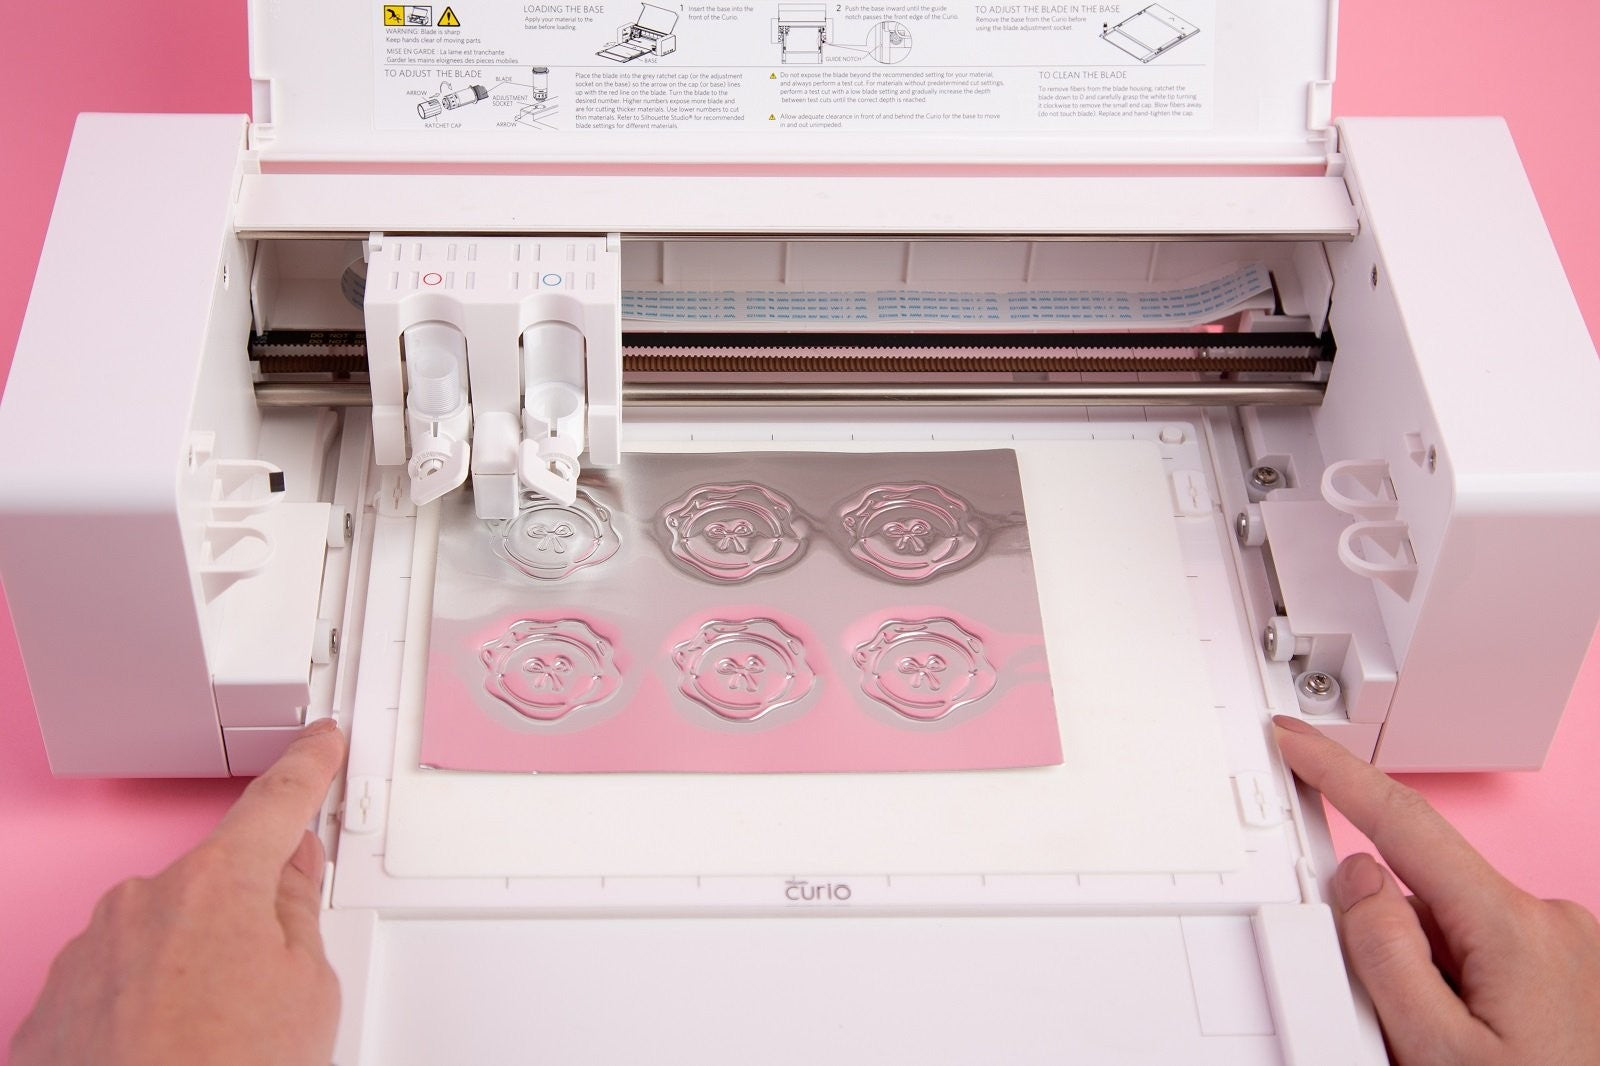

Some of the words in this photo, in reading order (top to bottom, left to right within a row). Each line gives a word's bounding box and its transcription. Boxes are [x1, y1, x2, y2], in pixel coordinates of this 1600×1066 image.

[931, 5, 947, 13] guide
[975, 5, 987, 14] TO
[989, 5, 1020, 14] ADJUST
[1023, 5, 1039, 14] THE
[1041, 5, 1068, 14] BLADE
[1070, 5, 1079, 14] IN
[1082, 5, 1097, 14] THE
[1099, 5, 1120, 14] BASE
[909, 13, 923, 21] edge
[444, 28, 460, 36] sharp
[976, 24, 991, 32] using
[1020, 24, 1052, 32] adjustment
[384, 70, 397, 78] TO
[399, 70, 432, 78] ADJUST
[436, 70, 452, 78] THE
[455, 70, 482, 78] BLADE
[1039, 71, 1050, 80] TO
[1053, 71, 1080, 80] CLEAN
[1083, 71, 1098, 80] THE
[1100, 71, 1127, 80] BLADE
[623, 97, 642, 105] Higher
[785, 884, 851, 900] curio
